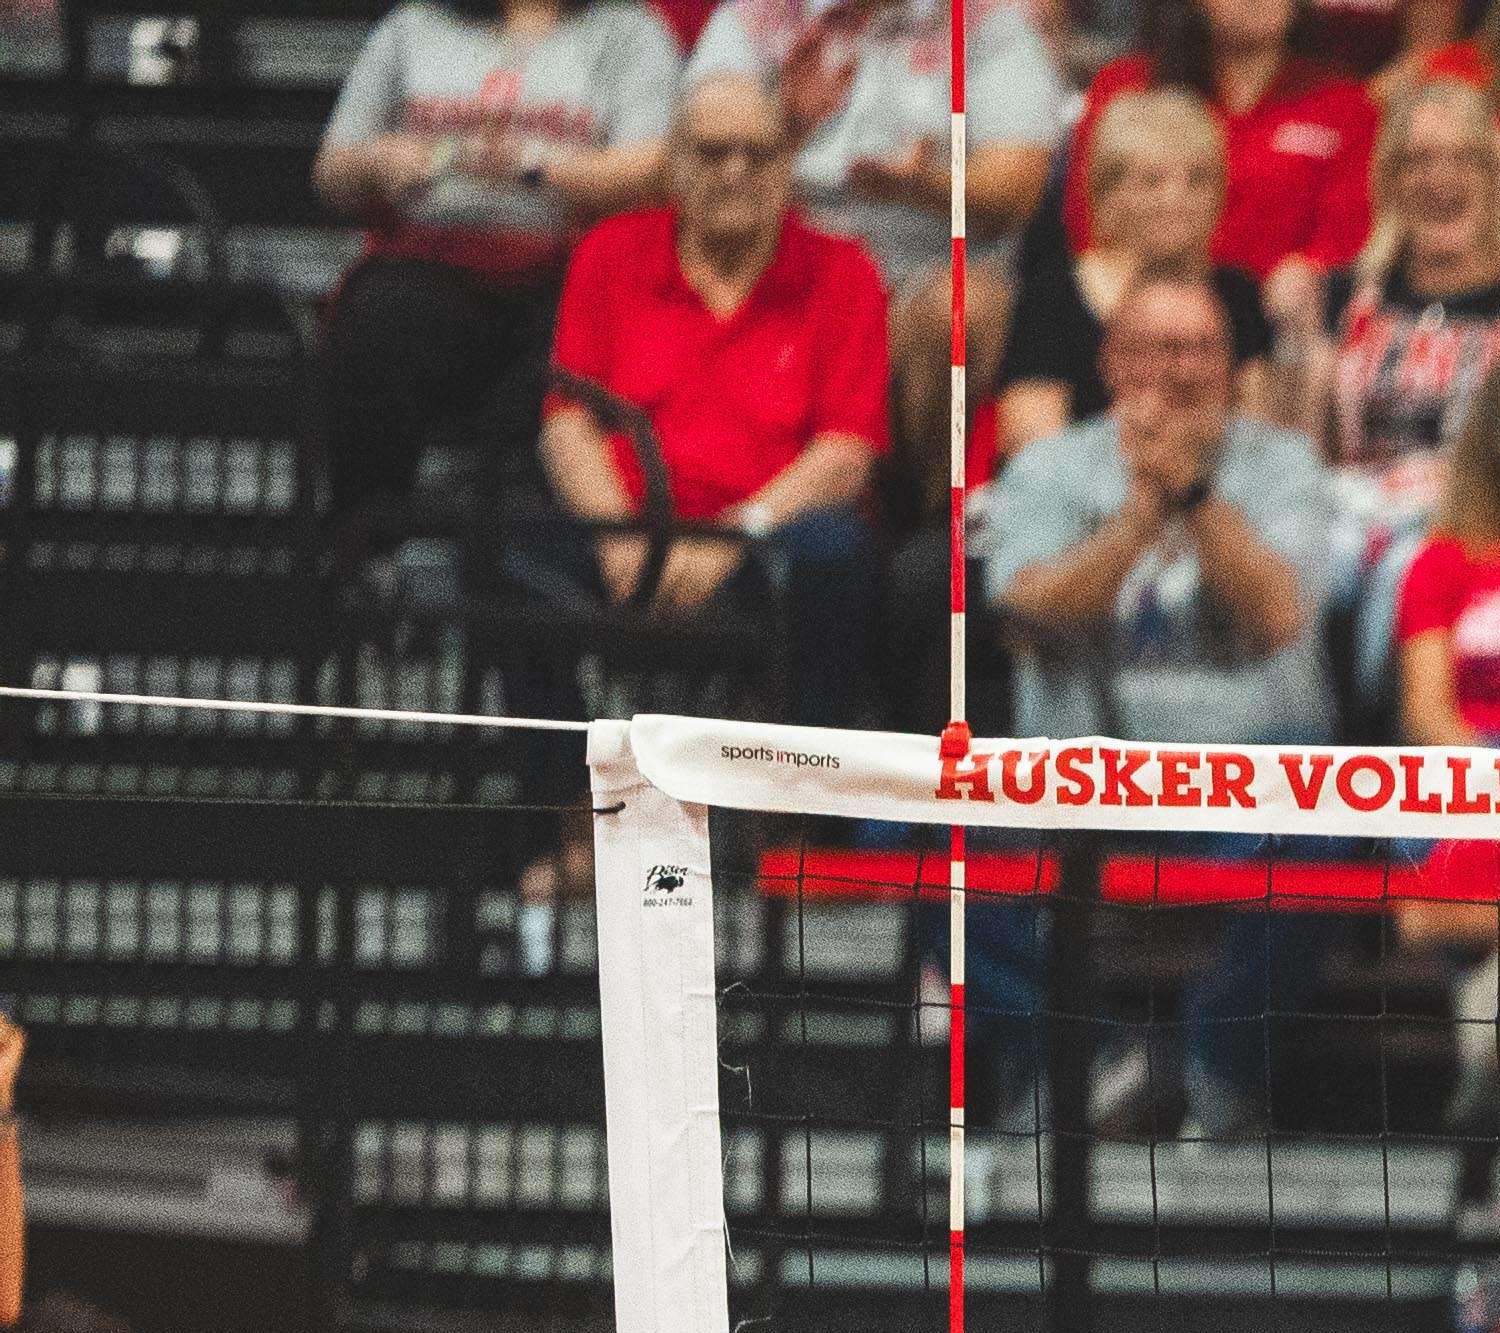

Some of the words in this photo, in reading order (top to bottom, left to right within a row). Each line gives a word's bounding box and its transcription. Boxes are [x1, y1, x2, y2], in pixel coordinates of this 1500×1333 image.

[721, 745, 774, 761] sports
[776, 750, 840, 769] imports
[935, 747, 1257, 809] HUSKER
